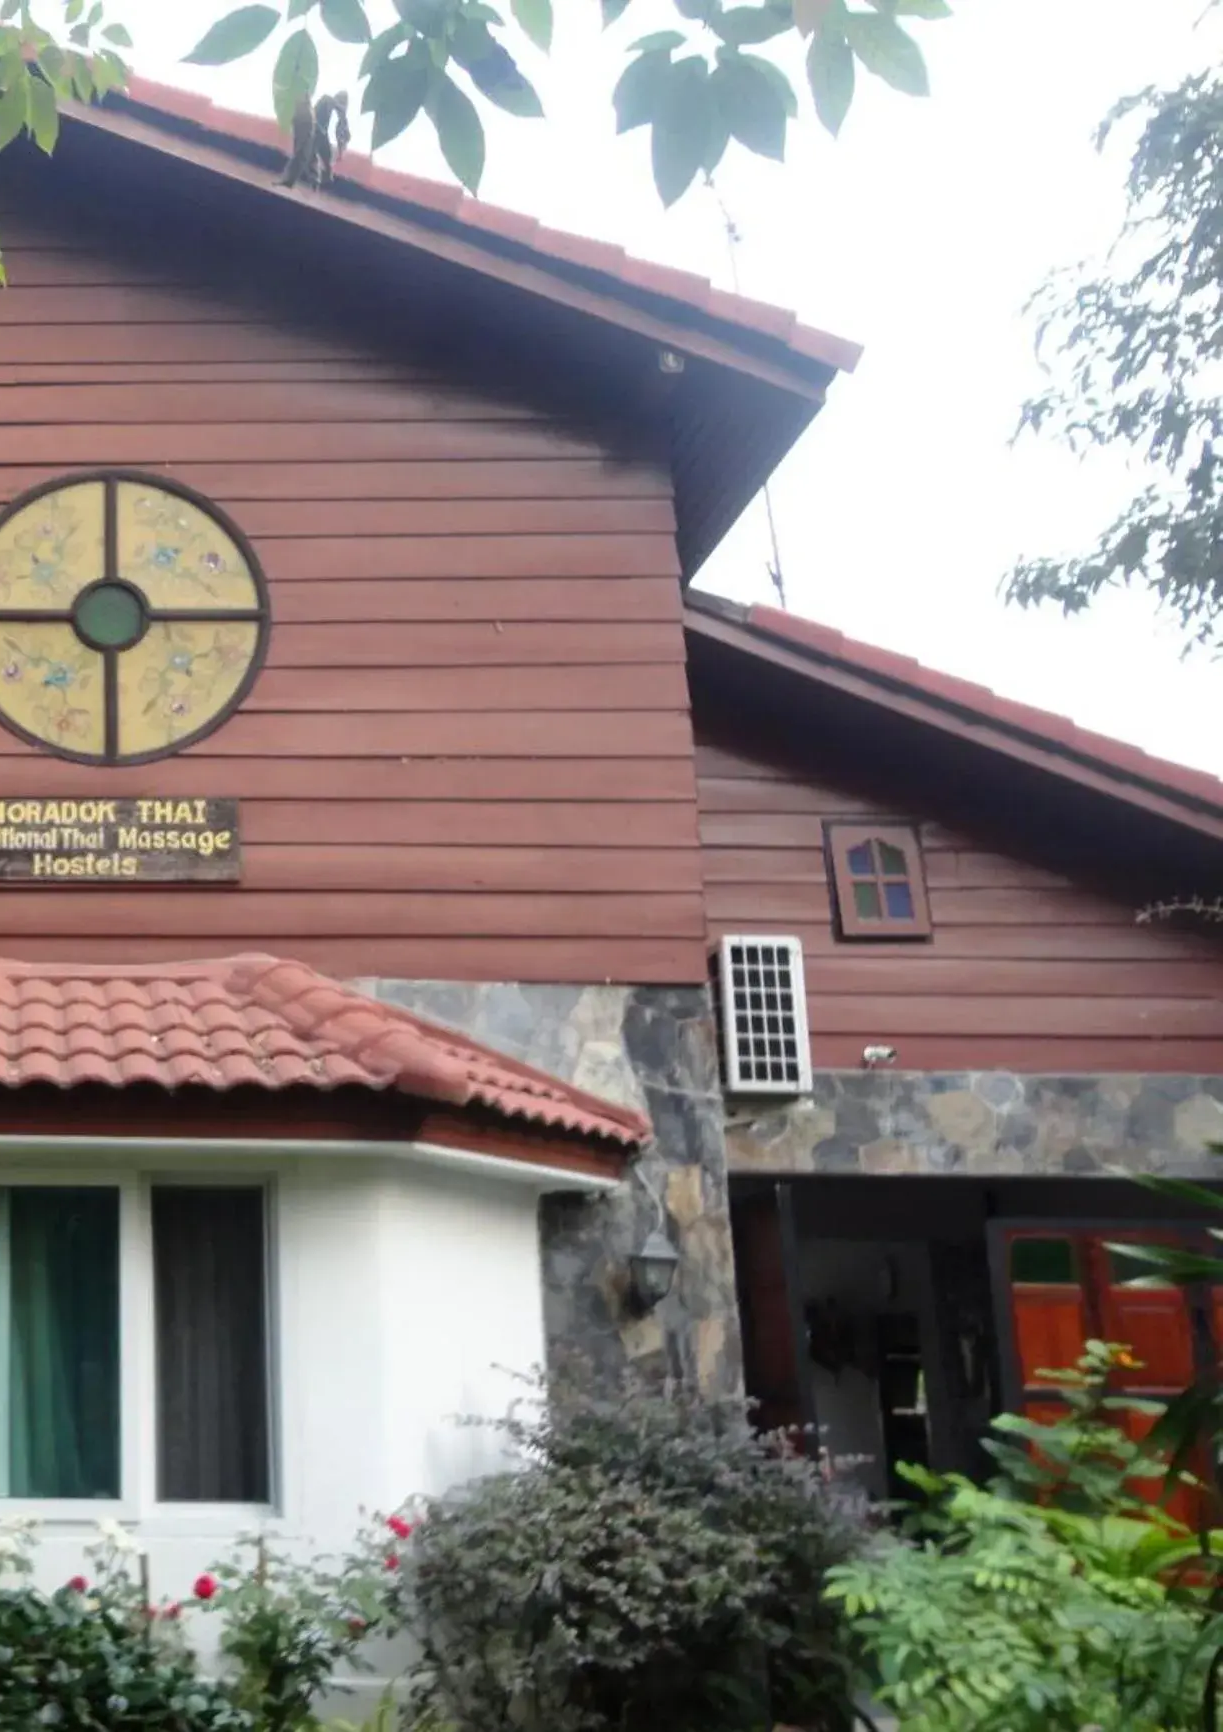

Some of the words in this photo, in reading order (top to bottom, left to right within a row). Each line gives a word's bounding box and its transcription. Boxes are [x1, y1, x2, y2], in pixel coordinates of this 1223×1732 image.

[136, 800, 207, 824] THAI
[59, 826, 104, 849] Thai
[118, 827, 231, 854] Massage
[33, 853, 138, 876] Hostels
